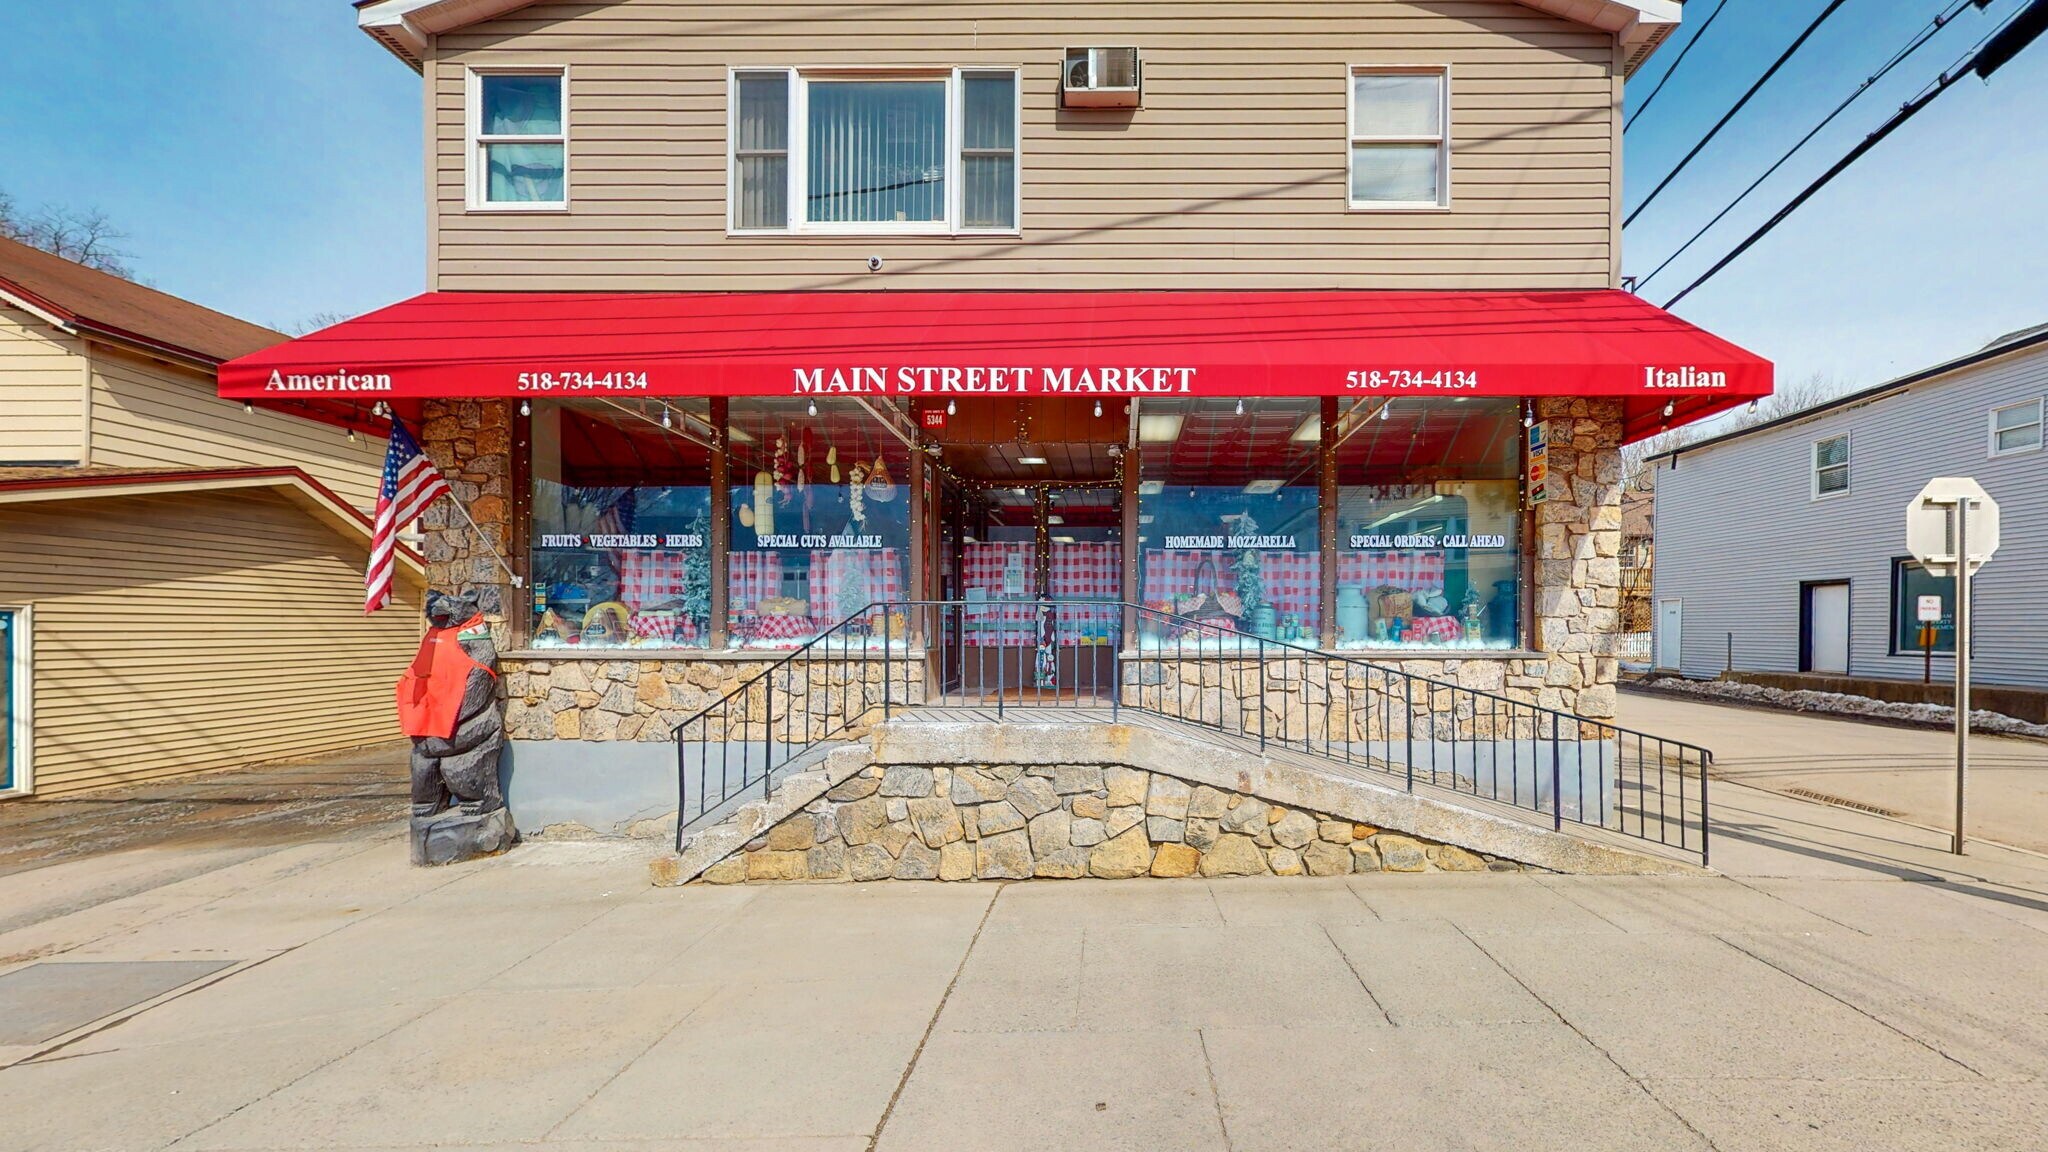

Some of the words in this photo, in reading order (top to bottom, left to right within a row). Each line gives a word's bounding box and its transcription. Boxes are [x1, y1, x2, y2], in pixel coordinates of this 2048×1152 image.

[264, 368, 392, 391] American
[517, 371, 648, 391] 518-734-4134
[793, 367, 889, 393] MAIN
[897, 366, 1033, 393] STREET
[1041, 367, 1197, 393] MARKET
[1345, 370, 1477, 389] 518-734-4134
[1644, 366, 1727, 388] Italian
[926, 414, 943, 425] 5344
[1533, 448, 1543, 457] VISA
[541, 533, 582, 548] FRUITS
[589, 533, 657, 548] VEGETABLES
[665, 533, 703, 548] HERBS
[757, 534, 799, 548] SPECIAL
[800, 534, 827, 548] CUTS
[828, 534, 882, 548] AVAILABLE
[1165, 535, 1224, 549] HOMEMADE
[1227, 535, 1297, 548] MOZZARELLA
[1350, 534, 1393, 548] SPECIAL
[1394, 534, 1435, 548] ORDERS
[1442, 534, 1468, 548] CALL
[1469, 534, 1505, 548] AHEAD
